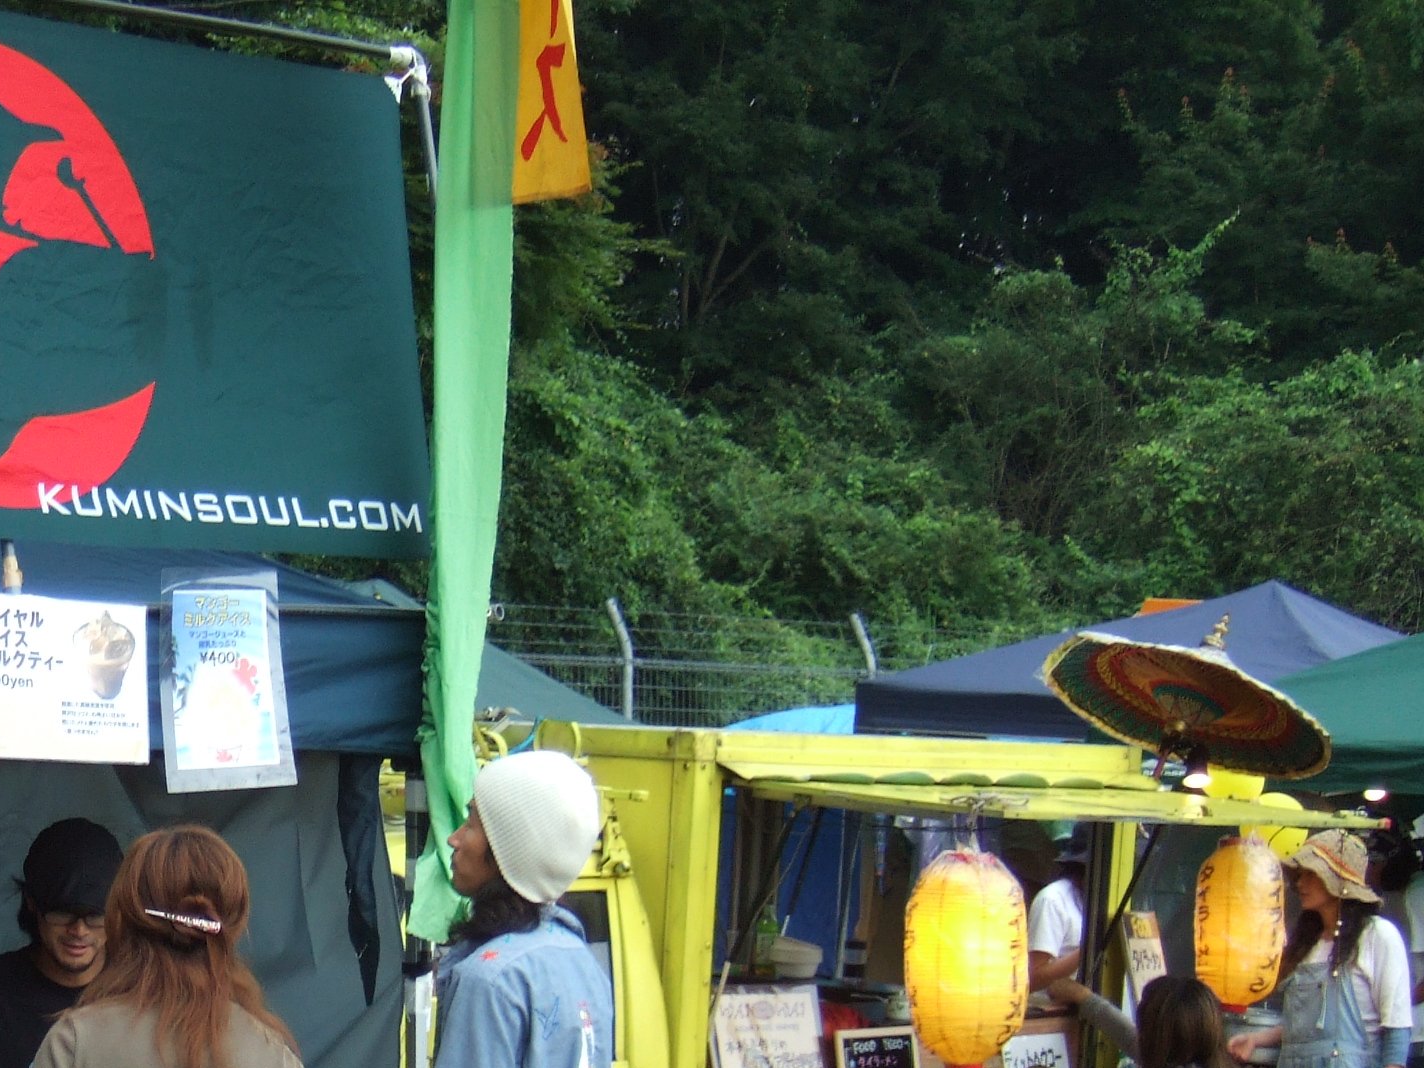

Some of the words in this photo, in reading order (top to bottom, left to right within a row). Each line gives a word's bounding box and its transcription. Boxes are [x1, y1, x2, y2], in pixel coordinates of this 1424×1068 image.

[37, 482, 423, 533] KUMINSOUL.COM
[195, 595, 240, 610] マンゴー
[184, 611, 251, 628] ミルクアイス
